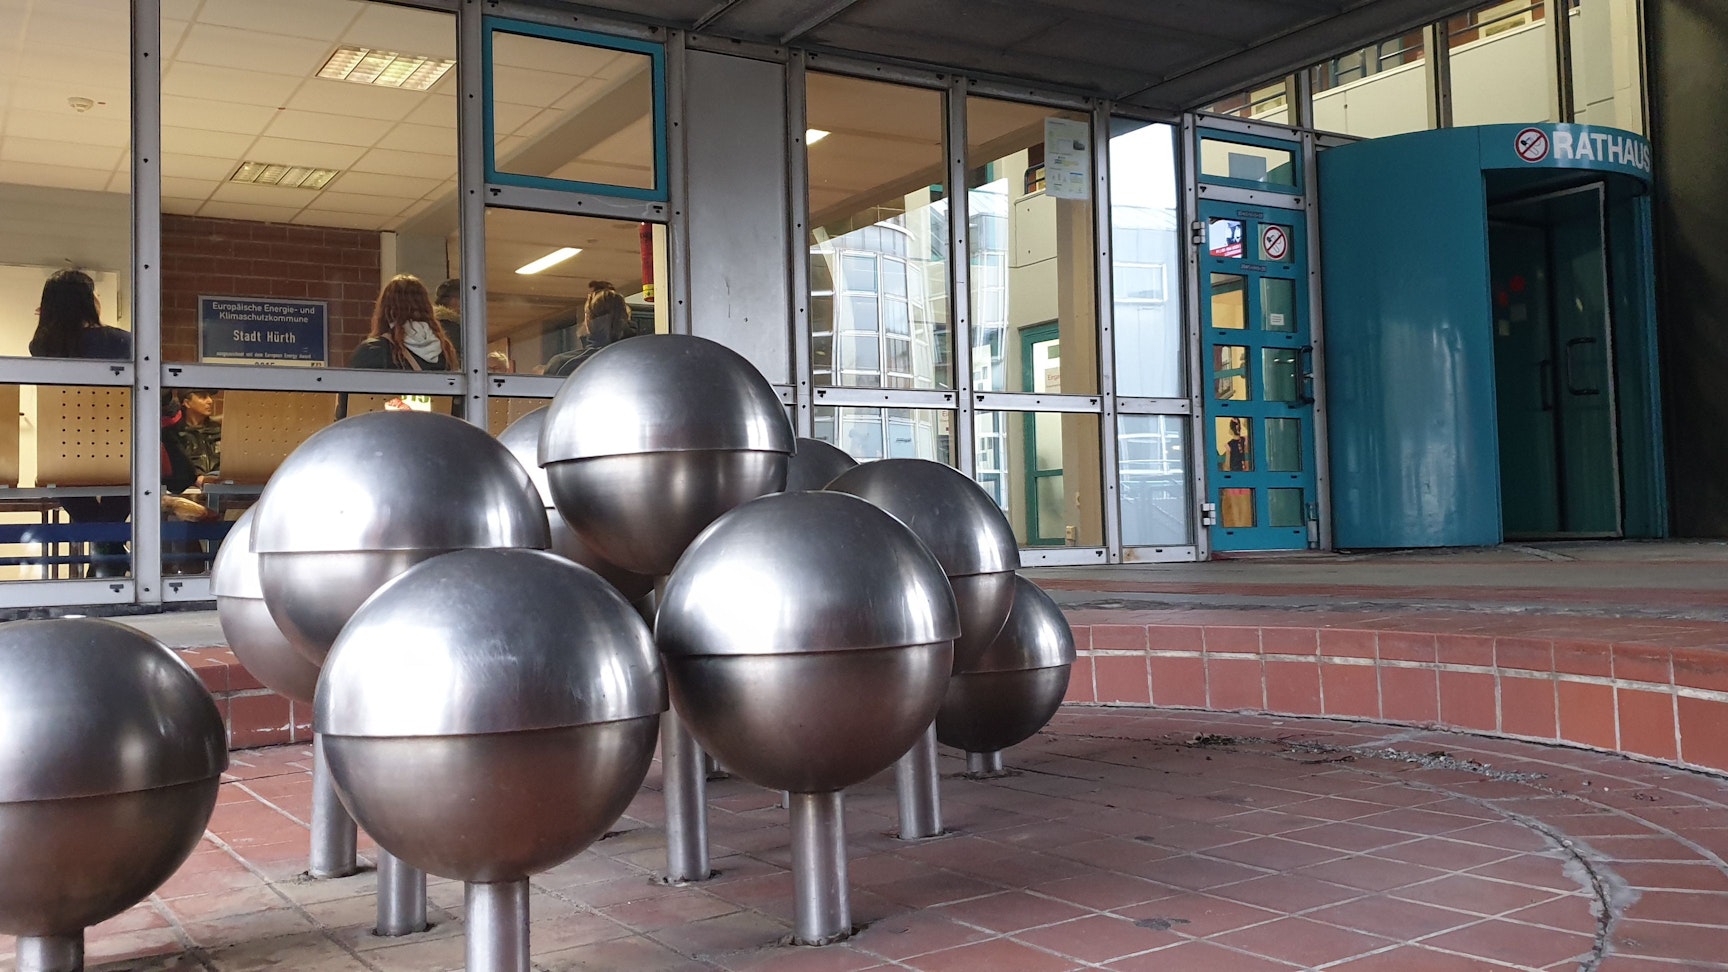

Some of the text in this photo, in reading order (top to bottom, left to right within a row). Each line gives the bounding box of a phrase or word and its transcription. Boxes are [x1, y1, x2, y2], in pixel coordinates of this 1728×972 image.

[1552, 131, 1650, 172] RATHAUS
[212, 301, 262, 312] Europäische
[264, 303, 298, 314] Energie-
[219, 311, 309, 323] Klimaschutzkommune
[233, 329, 296, 343] Stadt Hürth
